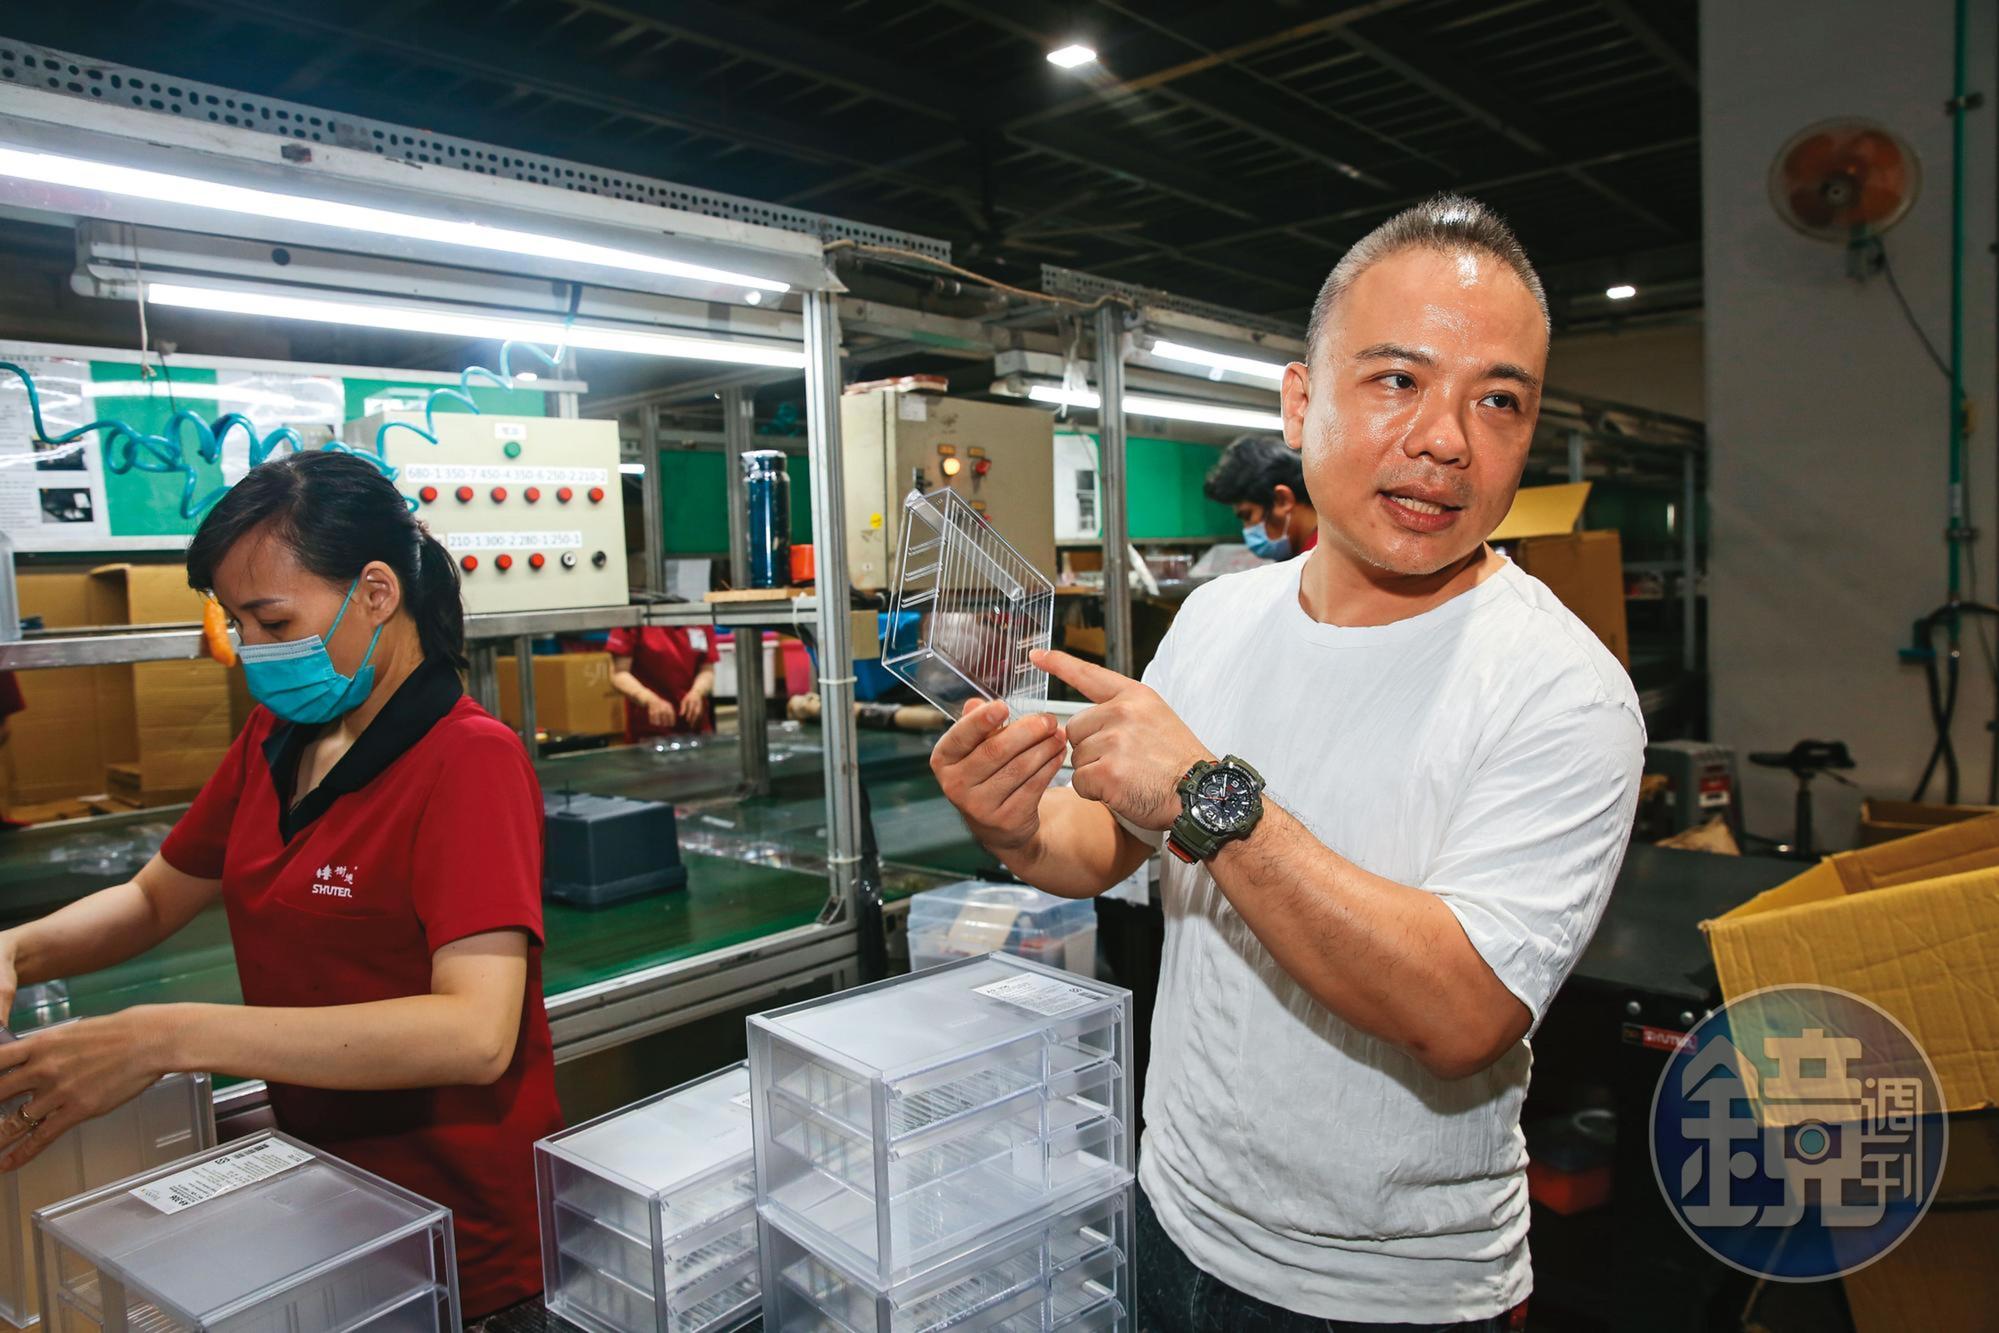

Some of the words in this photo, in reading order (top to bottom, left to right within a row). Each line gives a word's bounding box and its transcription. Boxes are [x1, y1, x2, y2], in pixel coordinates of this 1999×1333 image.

[407, 467, 442, 480] 680-1
[449, 535, 481, 547] 210-1
[551, 533, 580, 545] 250-1
[312, 884, 353, 898] SHUTER
